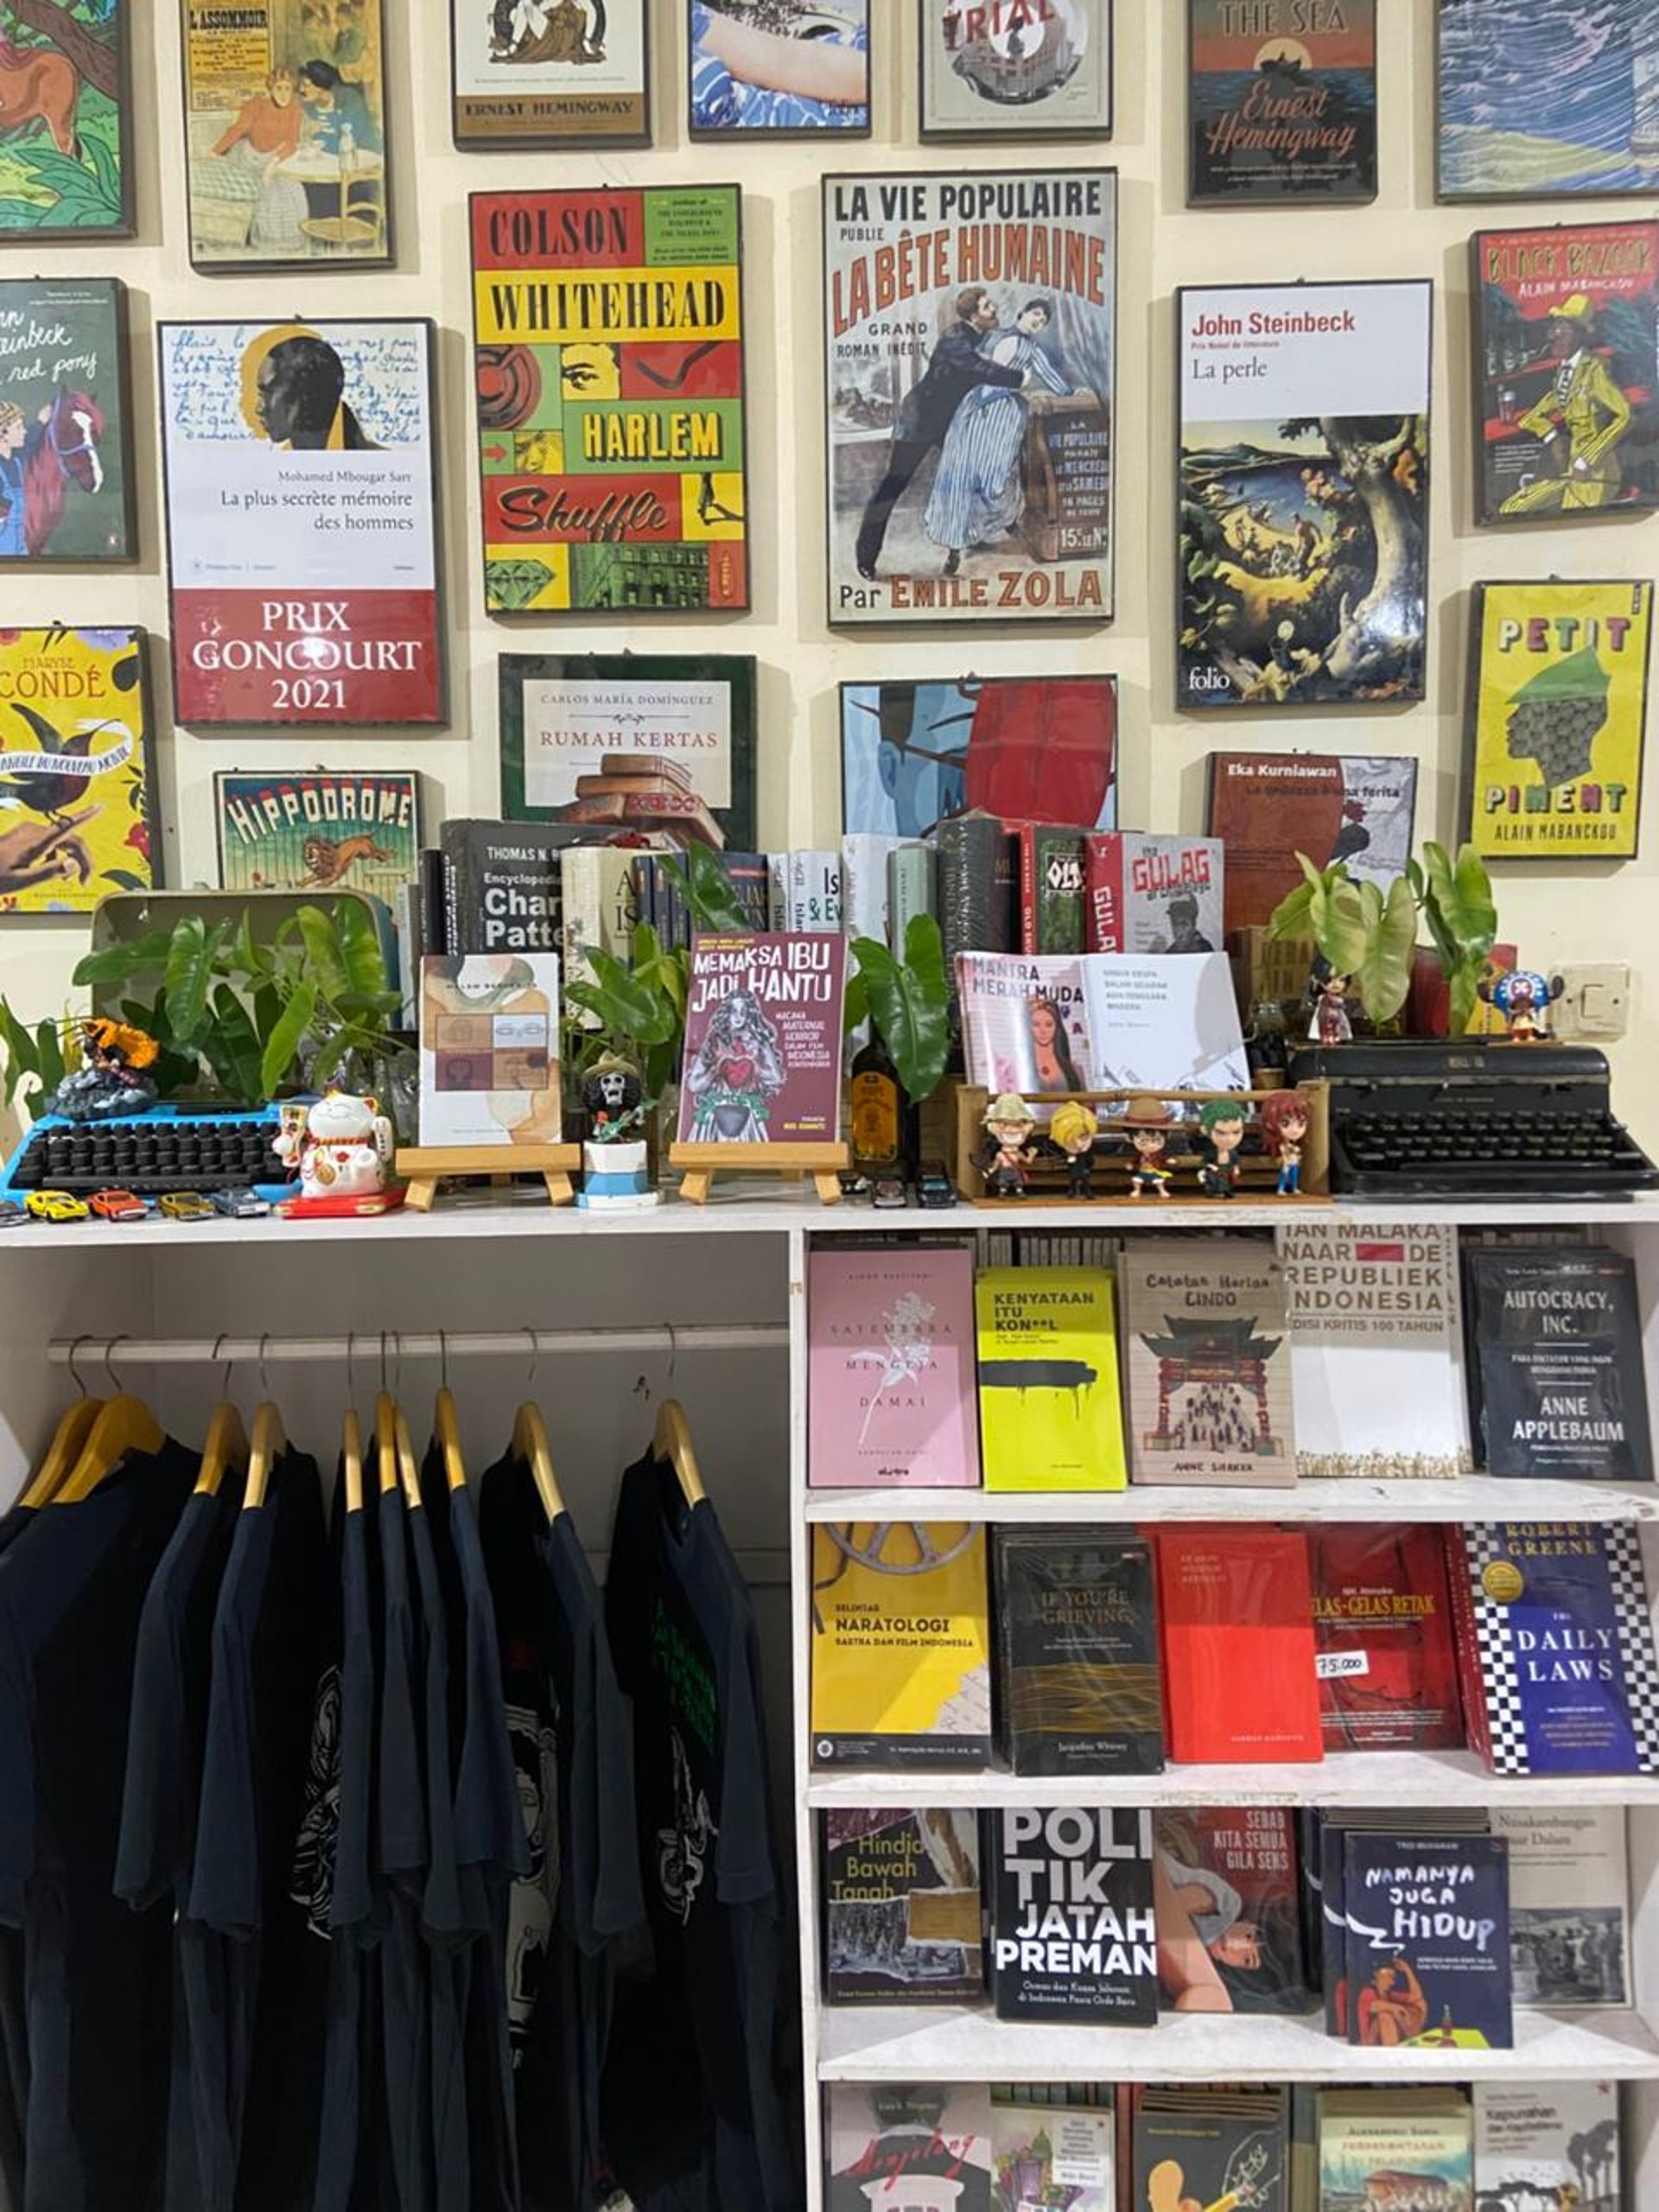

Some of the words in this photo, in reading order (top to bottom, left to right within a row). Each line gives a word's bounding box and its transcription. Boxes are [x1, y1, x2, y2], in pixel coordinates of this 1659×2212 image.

[189, 10, 268, 29] L'ASSOMMOIR
[1220, 4, 1278, 36] THE
[1291, 3, 1348, 34] SEA
[465, 102, 524, 117] ERNEST
[532, 100, 634, 116] HEMINGWAY
[1243, 79, 1330, 121] Ernest
[1206, 111, 1356, 157] Hemingway
[835, 187, 869, 222] LA
[879, 186, 927, 221] VIE
[940, 181, 1102, 221] POPULAIRE
[489, 207, 628, 257] COLSON
[840, 228, 884, 243] PUBLIE
[832, 257, 871, 339] LA
[874, 226, 950, 313] BÊTE
[957, 223, 1106, 307] HUMAINE
[1519, 281, 1556, 298] ALAIN
[491, 280, 725, 331] WHITEHEAD
[868, 322, 928, 336] GRAND
[1192, 314, 1243, 336] John
[1249, 310, 1356, 334] Steinbeck
[836, 344, 880, 359] ROMAN
[7, 362, 47, 384] red
[52, 353, 98, 383] pony
[1192, 359, 1216, 379] La
[1223, 356, 1268, 385] perle
[582, 412, 723, 461] HARLEM
[278, 470, 334, 483] Mohamed
[336, 470, 385, 486] Mbougar
[388, 471, 412, 483] Sarr
[221, 490, 239, 505] La
[245, 490, 278, 510] plus
[283, 489, 336, 505] secrète
[341, 489, 413, 505] mémoire
[315, 513, 341, 530] des
[346, 513, 414, 531] hommes
[498, 486, 669, 543] Shuffle
[840, 585, 881, 608] Par
[891, 574, 989, 608] EMILE
[998, 570, 1103, 607] ZOLA
[263, 602, 351, 632] PRIX
[1498, 617, 1631, 653] PETIT
[191, 640, 423, 671] GONCOURT
[1189, 666, 1230, 690] folio
[272, 679, 346, 709] 2021
[540, 694, 590, 705] CARLOS
[594, 692, 633, 705] MARÍA
[638, 693, 714, 706] DOMÍNGUEZ
[540, 732, 623, 747] RUMAH
[634, 732, 719, 748] KERTAS
[1228, 764, 1254, 776] Eka
[1257, 764, 1337, 777] Kurniawan
[1363, 785, 1400, 798] ferita
[1484, 782, 1628, 815] PIMENT
[226, 777, 413, 844] HIPPODROME
[1494, 823, 1534, 841] ALAIN
[1538, 822, 1617, 842] MABANCKOU
[486, 847, 536, 861] THOMAS
[537, 848, 550, 861] N.
[483, 873, 562, 887] Encyclopedi
[1133, 847, 1211, 893] GULAG
[484, 887, 562, 916] Char
[810, 899, 821, 921] &
[694, 945, 782, 975] MEMAKSA
[788, 943, 830, 970] IBU
[972, 957, 1040, 981] MANTRA
[747, 968, 832, 1002] HANTU
[972, 978, 1029, 996] MERAH
[1034, 984, 1085, 1003] MUDA
[1338, 1224, 1440, 1239] MALAKA
[1283, 1243, 1350, 1261] NAAR
[1410, 1244, 1440, 1262] DE
[1147, 1274, 1208, 1287] Catatan
[1287, 1267, 1442, 1287] REPUBLIEK
[995, 1293, 1094, 1306] KENYATAAN
[1185, 1292, 1236, 1306] CINDO
[1294, 1291, 1442, 1310] NDONESIA
[1503, 1290, 1615, 1313] AUTOCRACY,
[995, 1306, 1022, 1319] ITU
[1293, 1319, 1320, 1331] DISI
[1324, 1319, 1367, 1332] KRITIS
[1372, 1320, 1395, 1332] 100
[1398, 1320, 1442, 1332] TAHUN
[1542, 1316, 1578, 1333] INC.
[846, 1360, 938, 1370] MENGEJA
[860, 1396, 925, 1408] DAMAI
[1541, 1396, 1589, 1416] ANNE
[1513, 1421, 1624, 1441] APPLEBAUM
[1506, 1523, 1594, 1537] ROBERT
[1508, 1541, 1598, 1555] GREENE
[1393, 1595, 1436, 1615] RETAK
[836, 1618, 950, 1633] NARATOLOGI
[874, 1638, 893, 1647] DAN
[919, 1639, 974, 1649] INDONESIA
[1516, 1629, 1612, 1651] DAILY
[1318, 1658, 1362, 1674] 75.000
[1528, 1659, 1614, 1682] LAWS
[1246, 1811, 1285, 1828] SEBAB
[1003, 1807, 1153, 1859] POLI
[1214, 1830, 1242, 1848] KITA
[1245, 1831, 1287, 1849] SEMUA
[1532, 1832, 1571, 1847] Dalam
[847, 1857, 917, 1878] Bawah
[1226, 1852, 1255, 1869] GILA
[1004, 1859, 1114, 1910] TIK
[1365, 1866, 1474, 1888] NAMANYA
[832, 1880, 894, 1900] Tanah
[1389, 1887, 1455, 1904] JUGA
[1015, 1904, 1156, 1942] JATAH
[1394, 1908, 1496, 1951] HIDUP
[996, 1939, 1157, 1976] PREMAN
[1029, 1993, 1066, 2004] Indonesia
[1093, 1994, 1115, 2005] Orde
[1116, 1995, 1136, 2005] Baru
